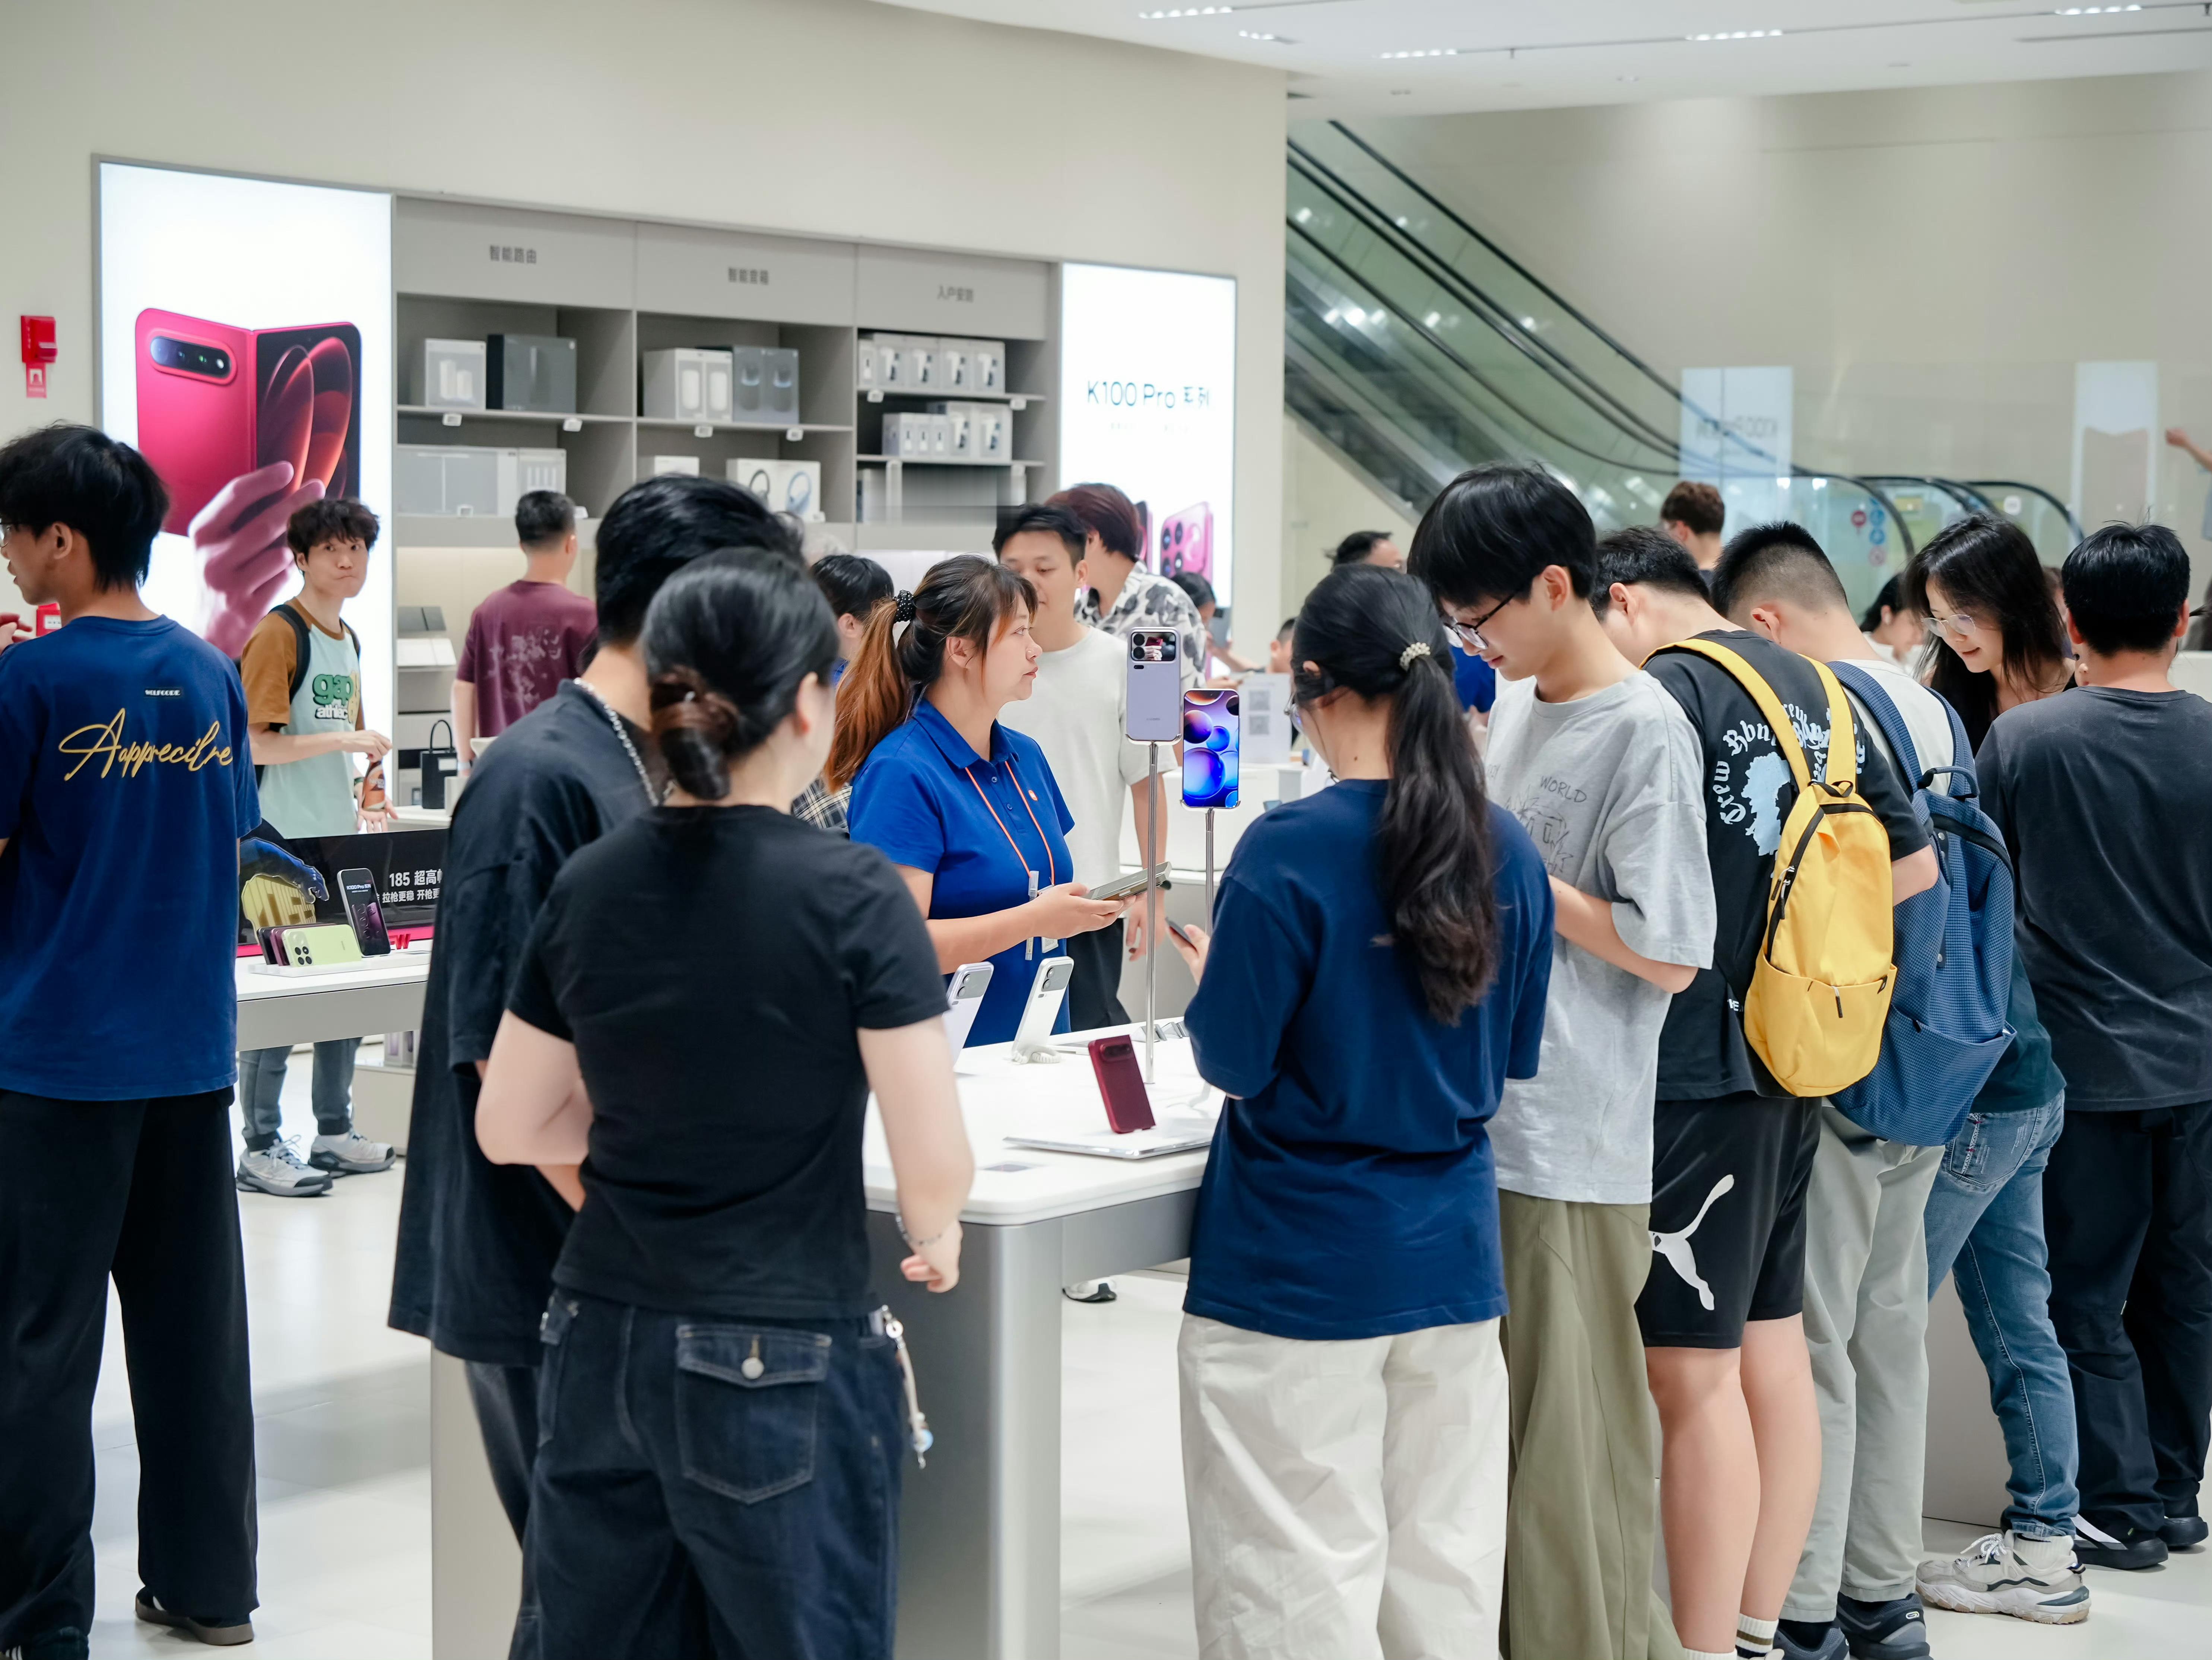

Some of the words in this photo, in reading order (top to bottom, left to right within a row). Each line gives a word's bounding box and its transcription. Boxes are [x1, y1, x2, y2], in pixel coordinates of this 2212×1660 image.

[1087, 381, 1137, 406] K100
[1143, 383, 1175, 409] Pro
[1540, 775, 1587, 803] WORLD
[389, 872, 410, 887] 185
[382, 890, 415, 903] 拉枪更稳
